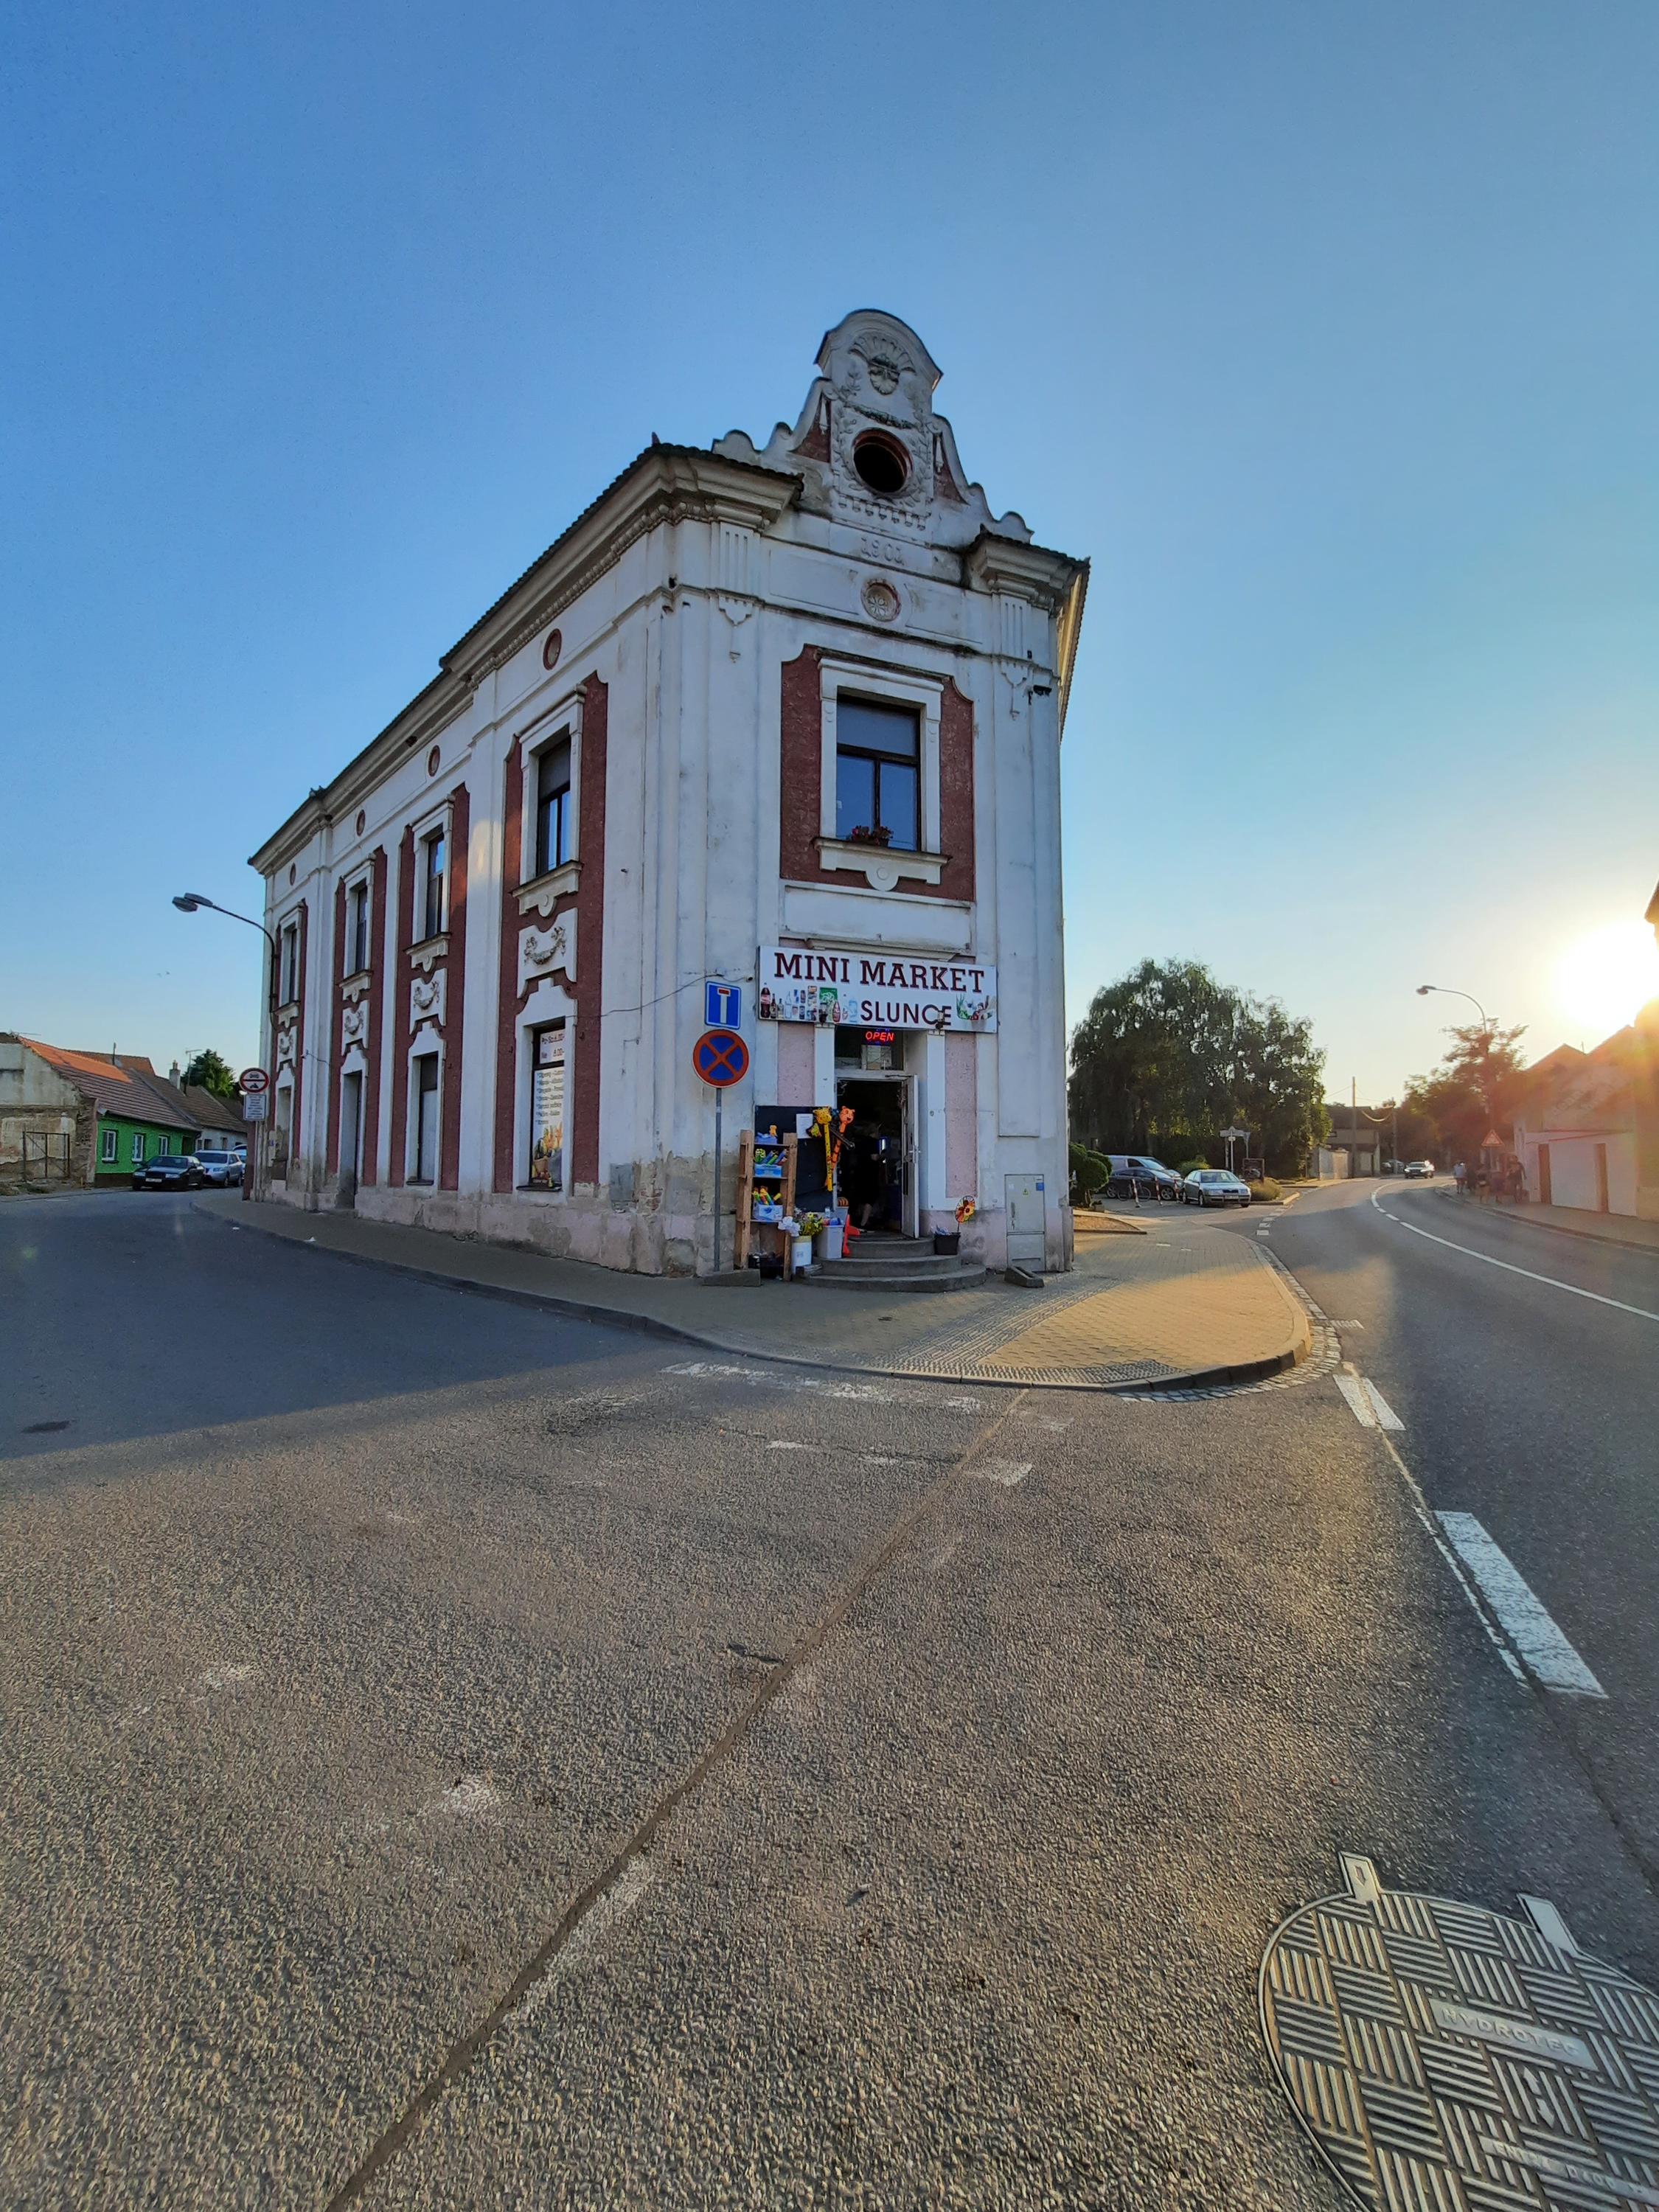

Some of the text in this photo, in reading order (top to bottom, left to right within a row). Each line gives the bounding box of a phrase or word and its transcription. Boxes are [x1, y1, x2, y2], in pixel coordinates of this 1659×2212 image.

[774, 952, 984, 993] MINI MARKET
[860, 1000, 952, 1026] SLUNCE
[865, 1031, 894, 1042] OPEN
[1441, 2007, 1579, 2056] HYDROTEC
